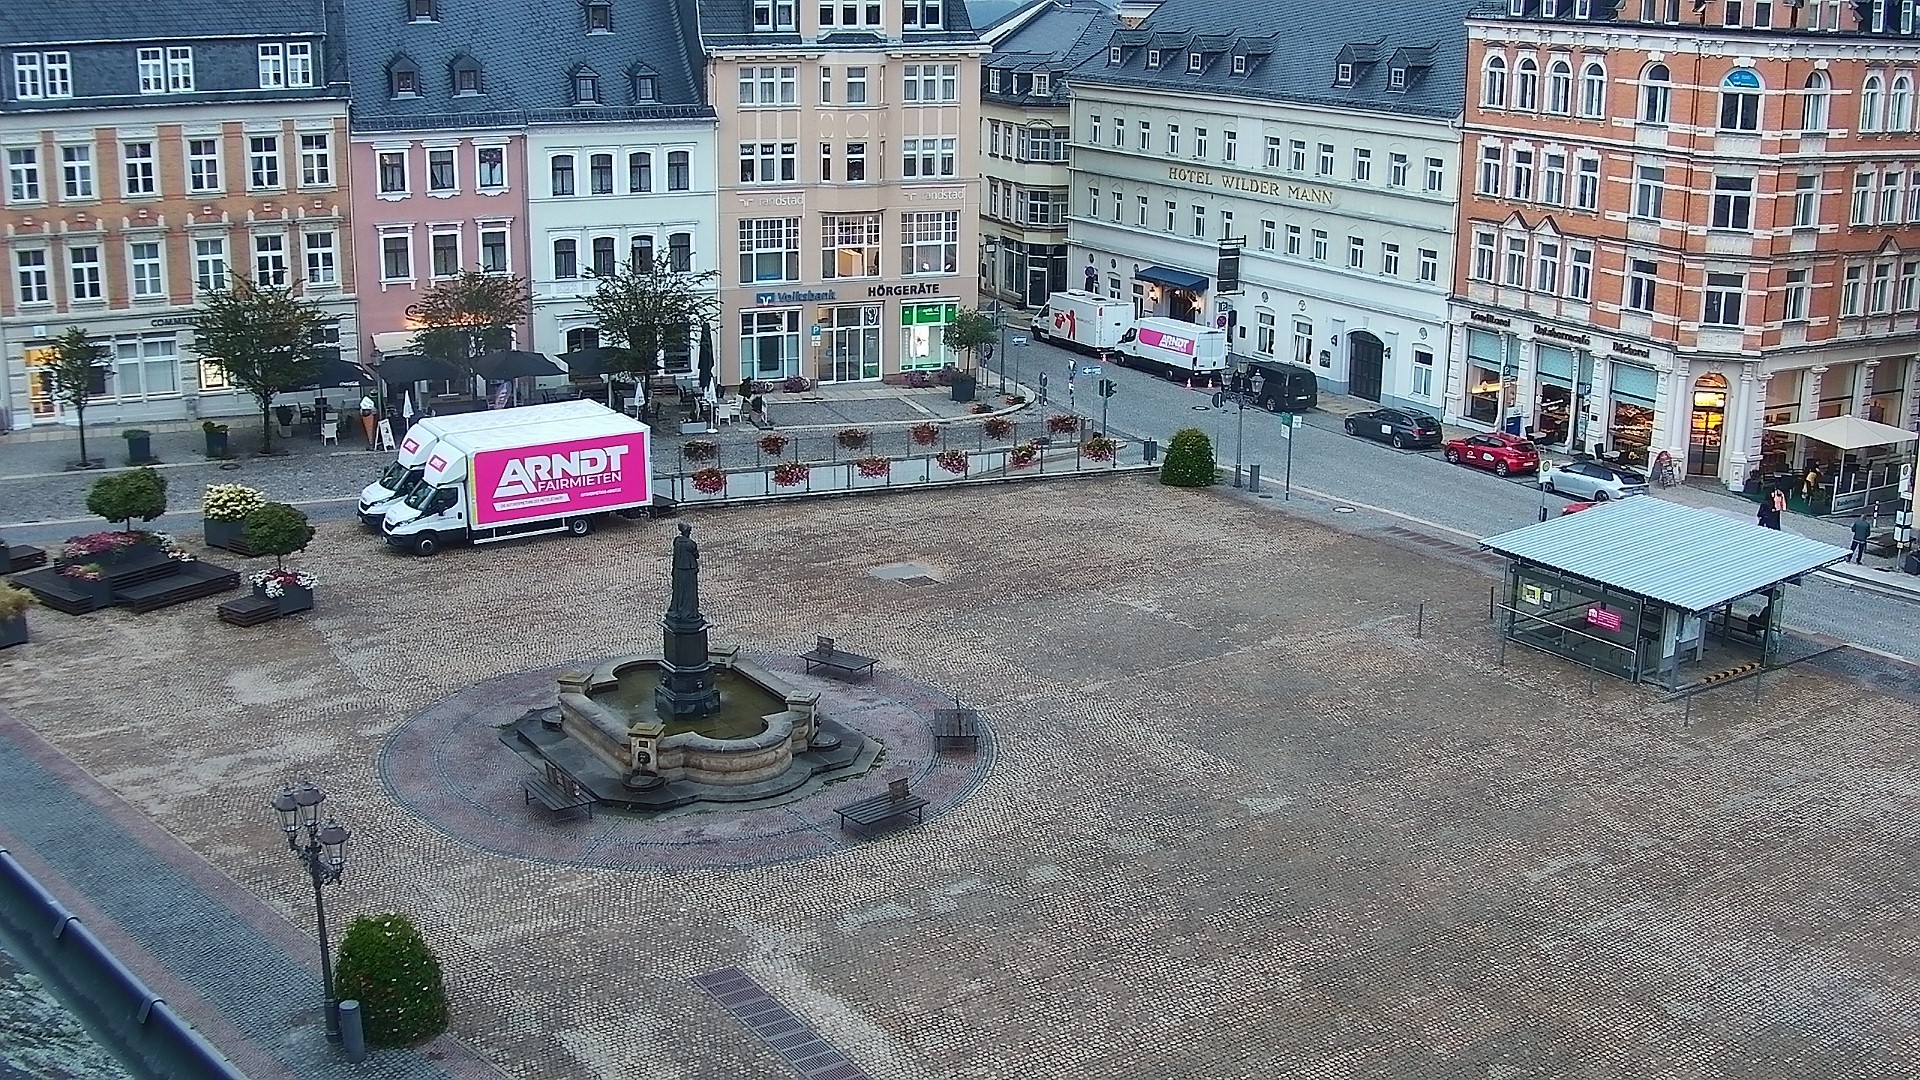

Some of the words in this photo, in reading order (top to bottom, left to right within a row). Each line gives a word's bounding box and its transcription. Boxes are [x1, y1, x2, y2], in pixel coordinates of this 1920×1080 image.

[1168, 167, 1213, 186] HOTEL
[1222, 174, 1280, 196] WILDER
[1288, 185, 1333, 204] MANN
[759, 193, 804, 206] randstad
[922, 188, 964, 200] randstad
[777, 289, 836, 302] Volksbank
[867, 282, 940, 297] HÖRGERÄTE
[1159, 334, 1190, 349] ARNDT
[493, 445, 629, 499] ARNDT
[538, 471, 622, 492] FAIRMIETEN
